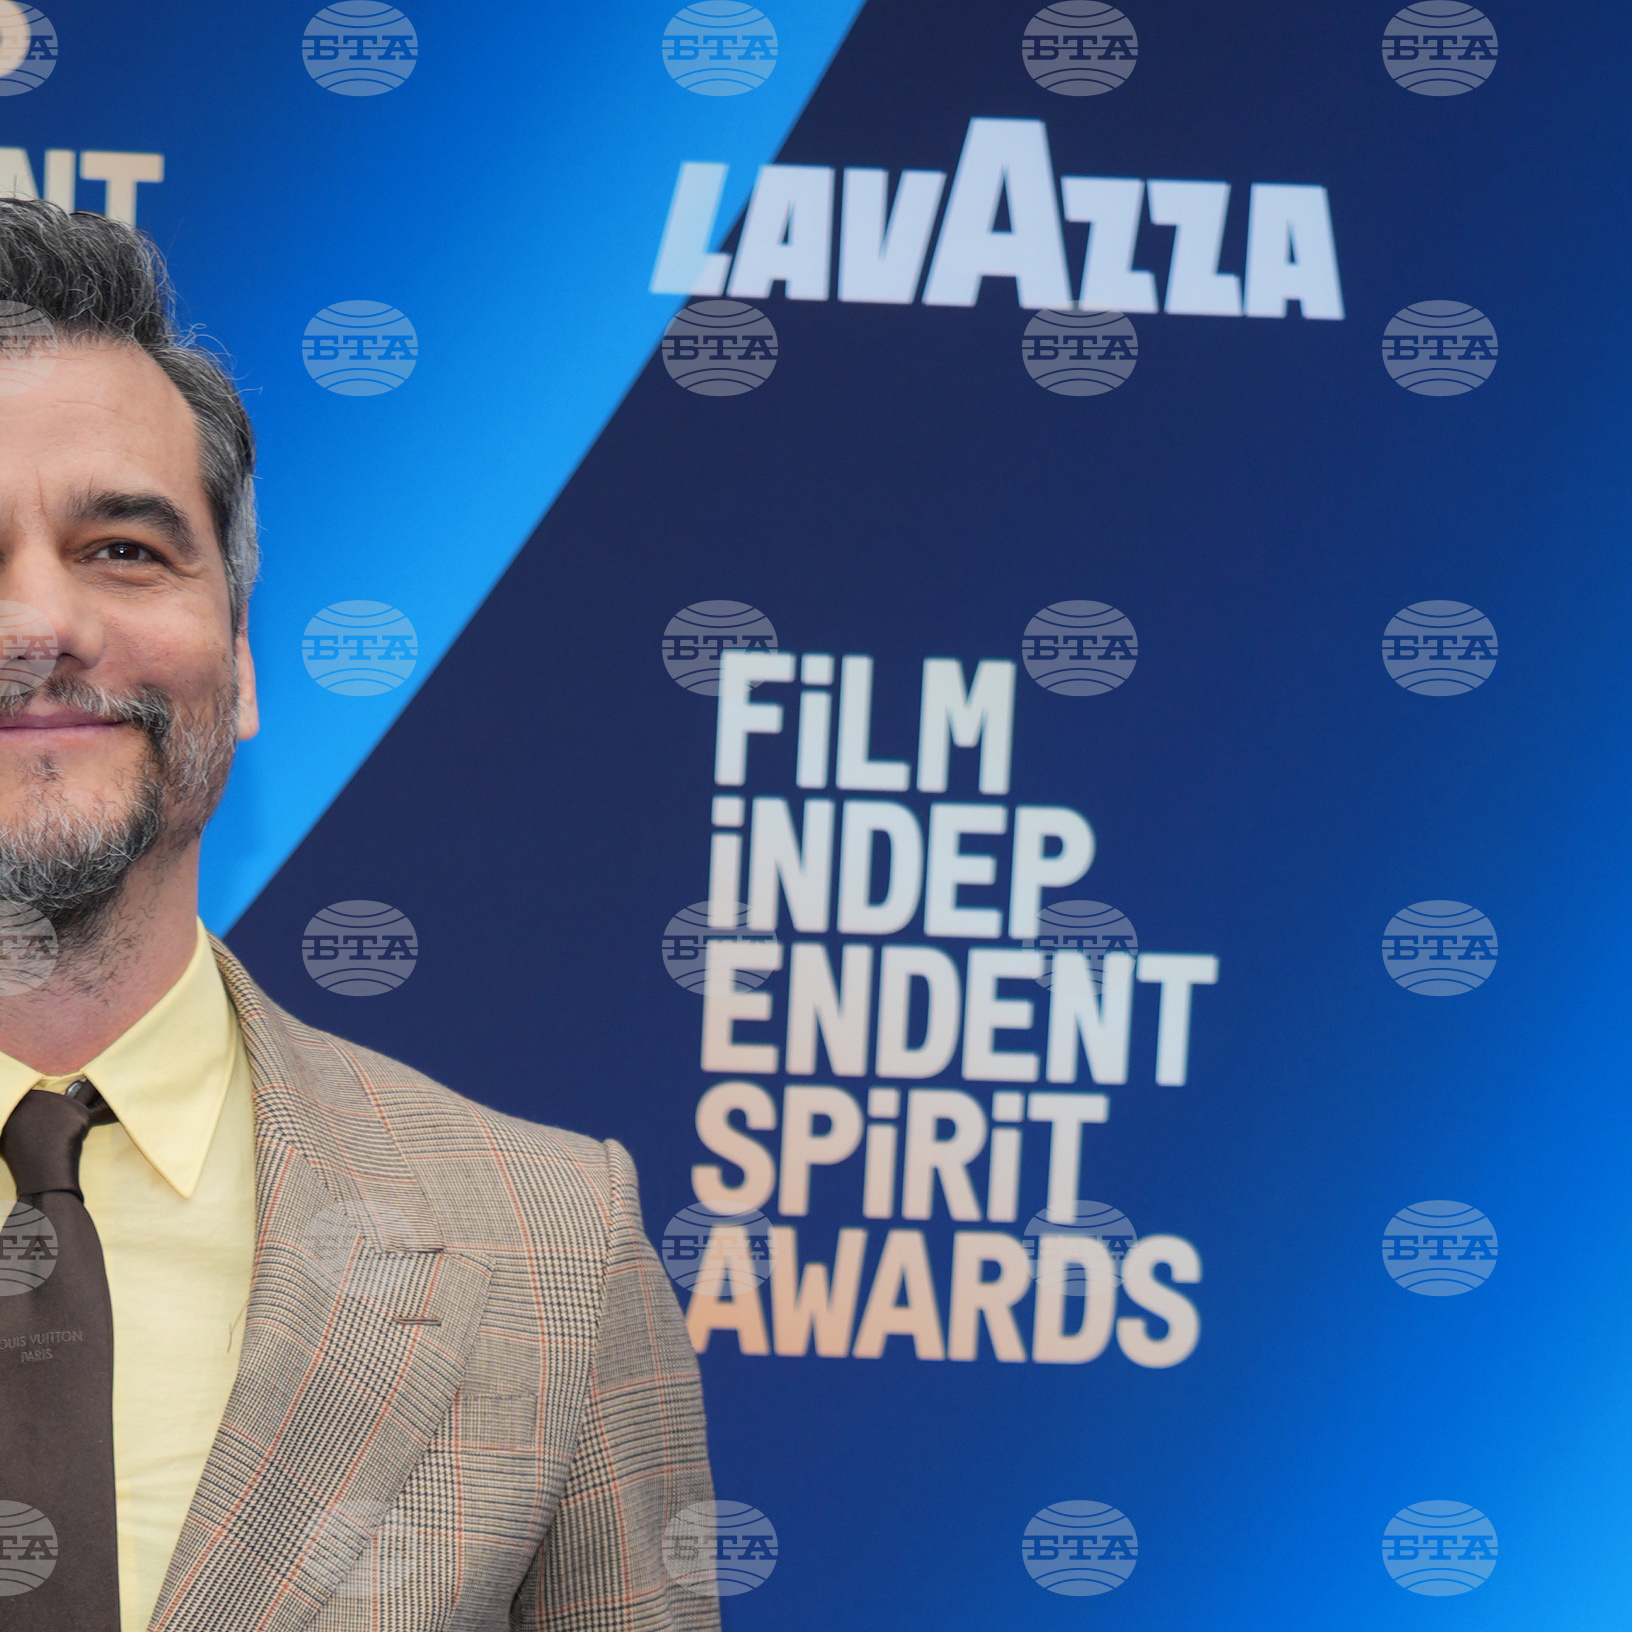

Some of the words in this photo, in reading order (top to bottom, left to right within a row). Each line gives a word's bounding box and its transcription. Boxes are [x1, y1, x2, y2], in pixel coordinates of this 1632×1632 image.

[650, 119, 1342, 320] LAVAZZA
[715, 650, 1015, 795] FiLM
[707, 796, 1094, 940] iNDEP
[701, 939, 1217, 1086] ENDENT
[691, 1081, 1108, 1225] SPiRiT
[20, 1348, 54, 1363] PARIS
[29, 1330, 84, 1345] VUITTON
[684, 1223, 1200, 1368] AWARDS
